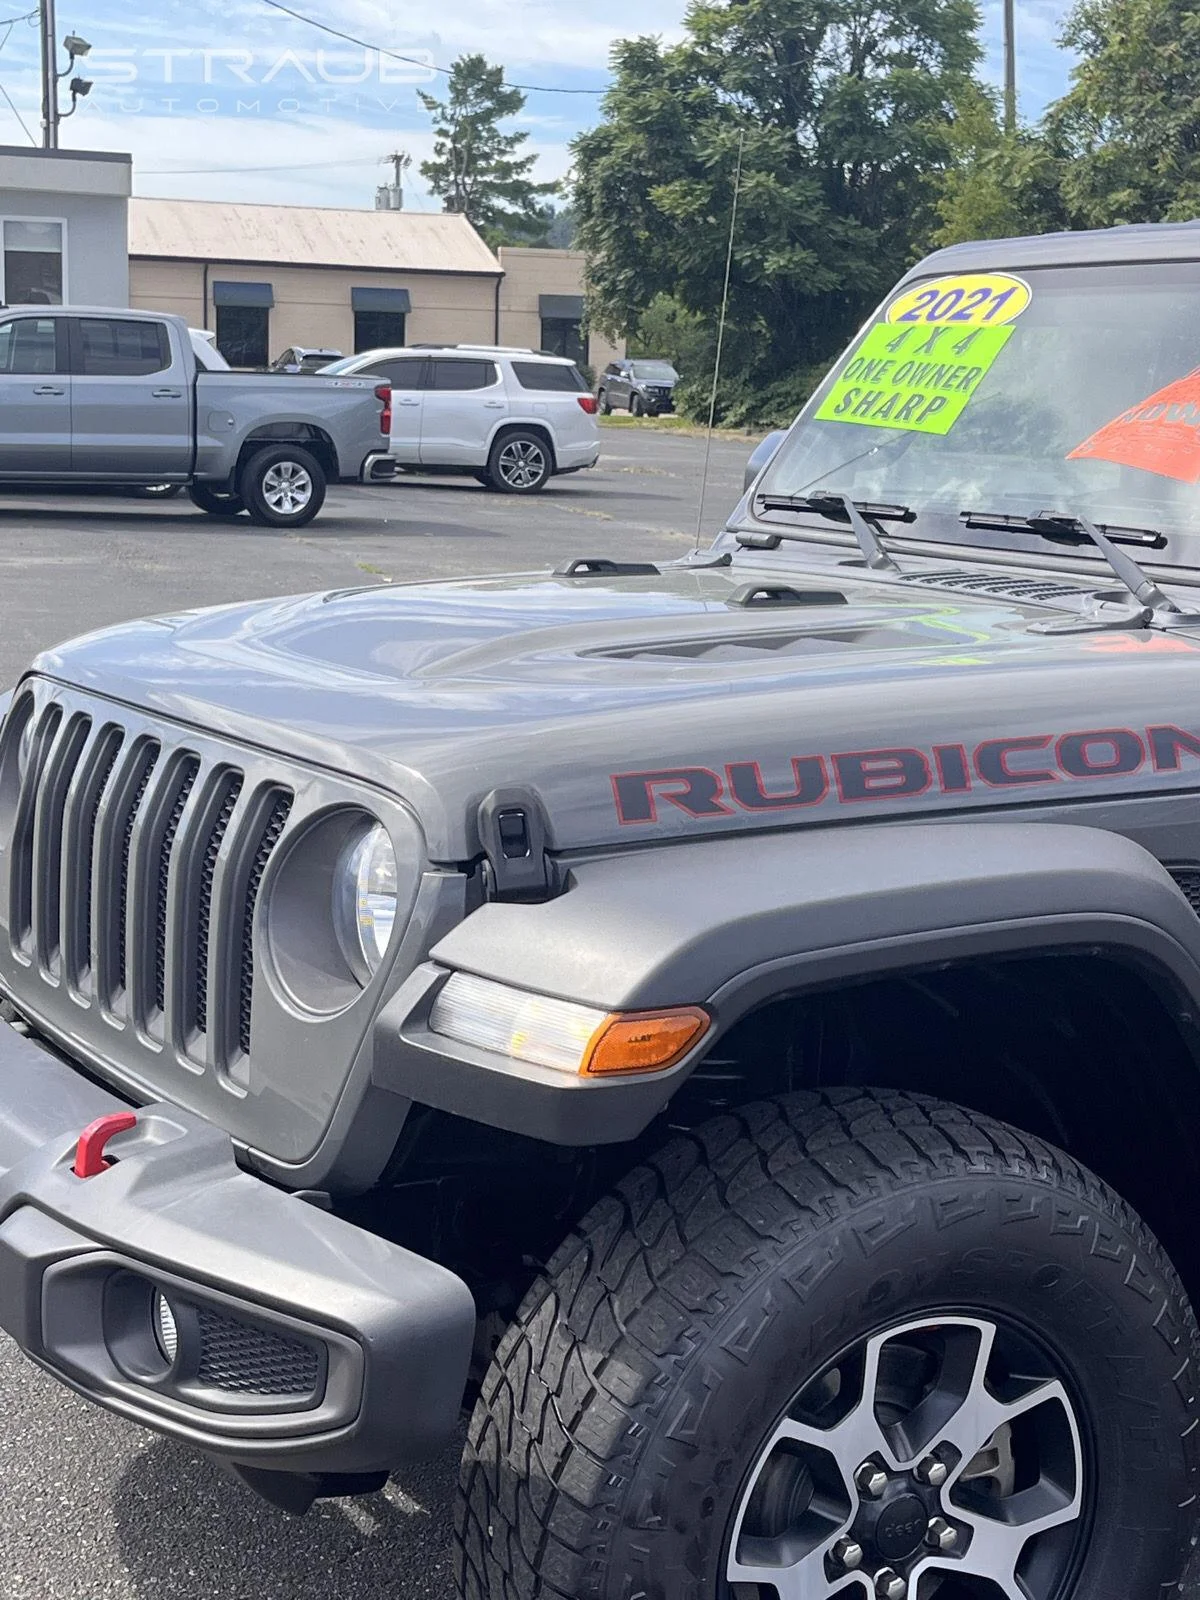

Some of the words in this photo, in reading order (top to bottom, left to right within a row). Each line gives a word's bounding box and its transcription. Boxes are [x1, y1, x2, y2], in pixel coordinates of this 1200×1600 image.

[896, 286, 1019, 322] 2021
[885, 326, 915, 354] 4
[951, 327, 985, 356] 4
[842, 357, 897, 384] ONE
[891, 360, 983, 393] OWNER
[833, 387, 949, 424] SHARP
